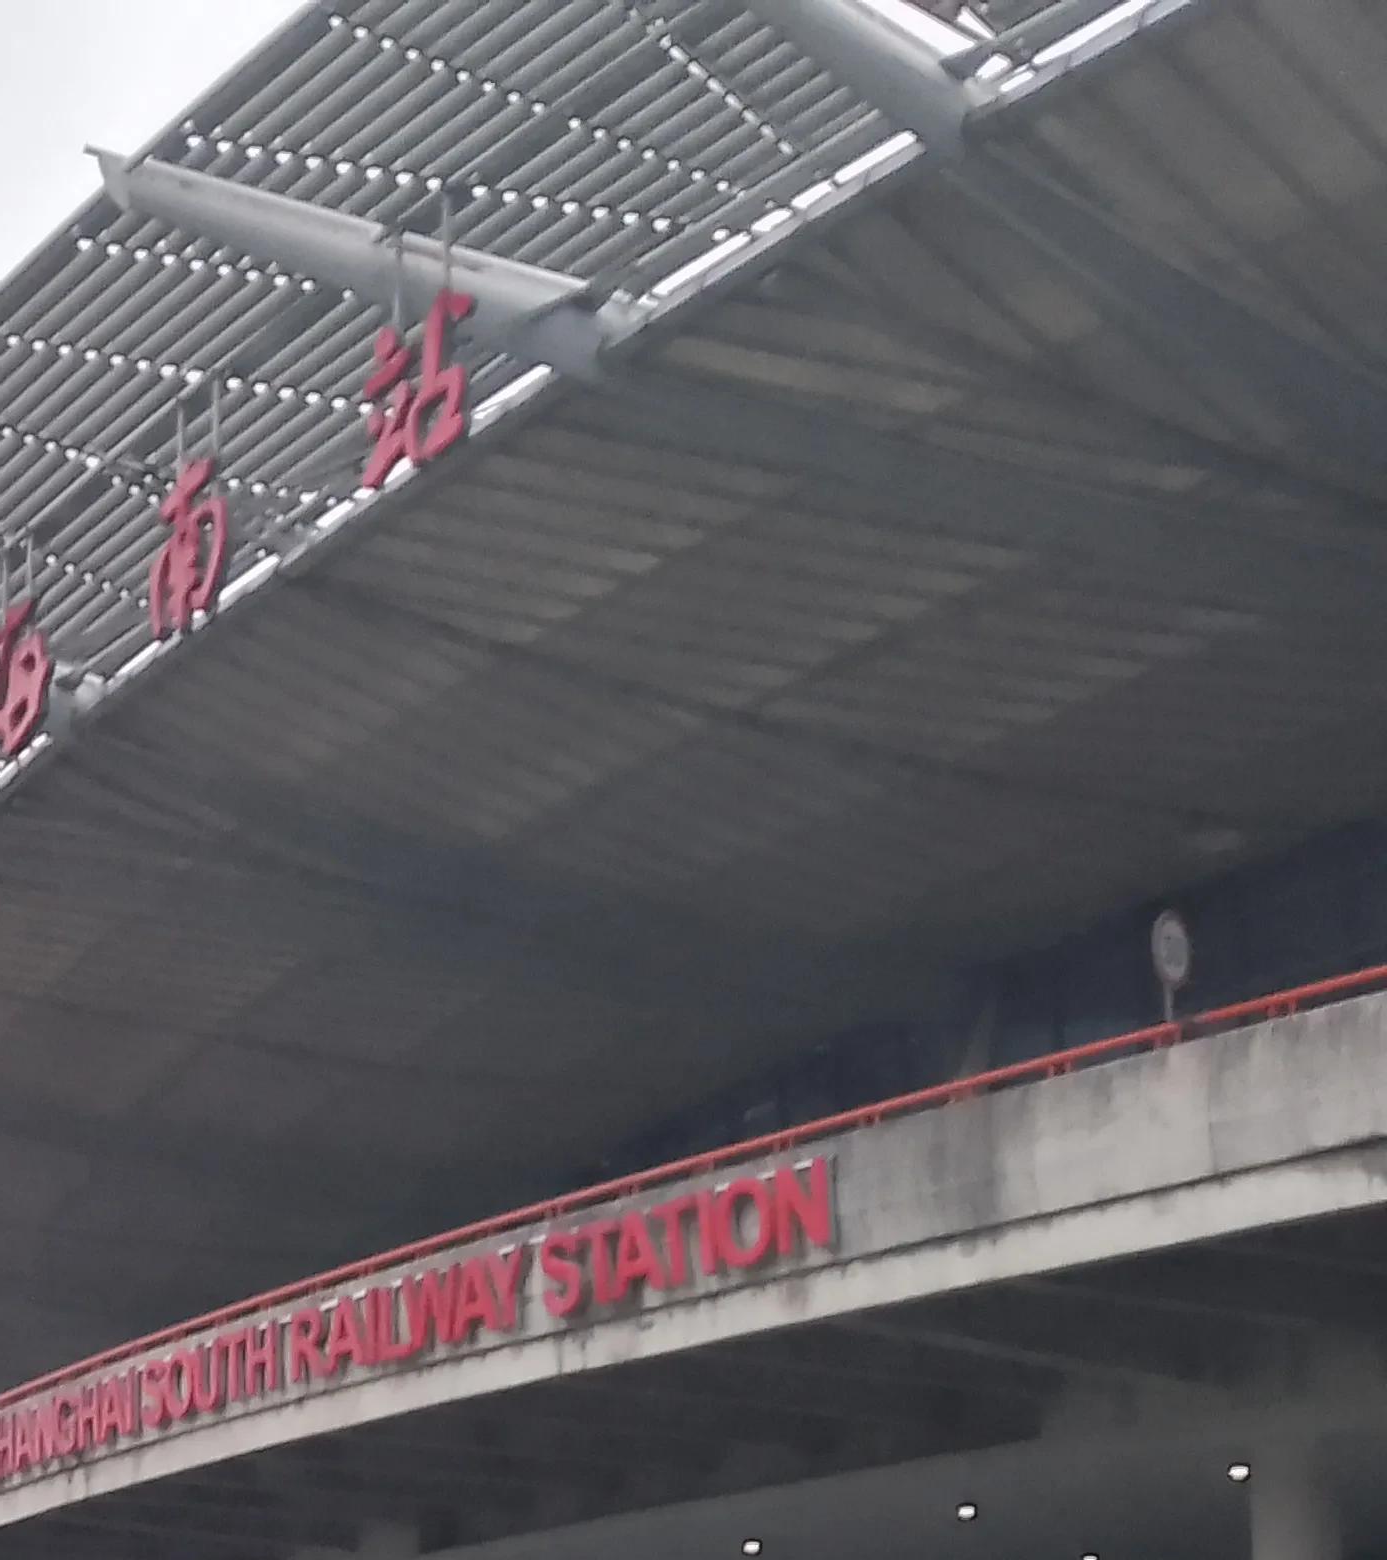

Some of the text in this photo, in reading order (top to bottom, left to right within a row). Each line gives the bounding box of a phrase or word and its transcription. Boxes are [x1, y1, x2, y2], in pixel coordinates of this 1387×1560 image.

[138, 1320, 278, 1429] SOUTH
[289, 1246, 525, 1383] RAILWAY
[539, 1156, 833, 1319] STATION
